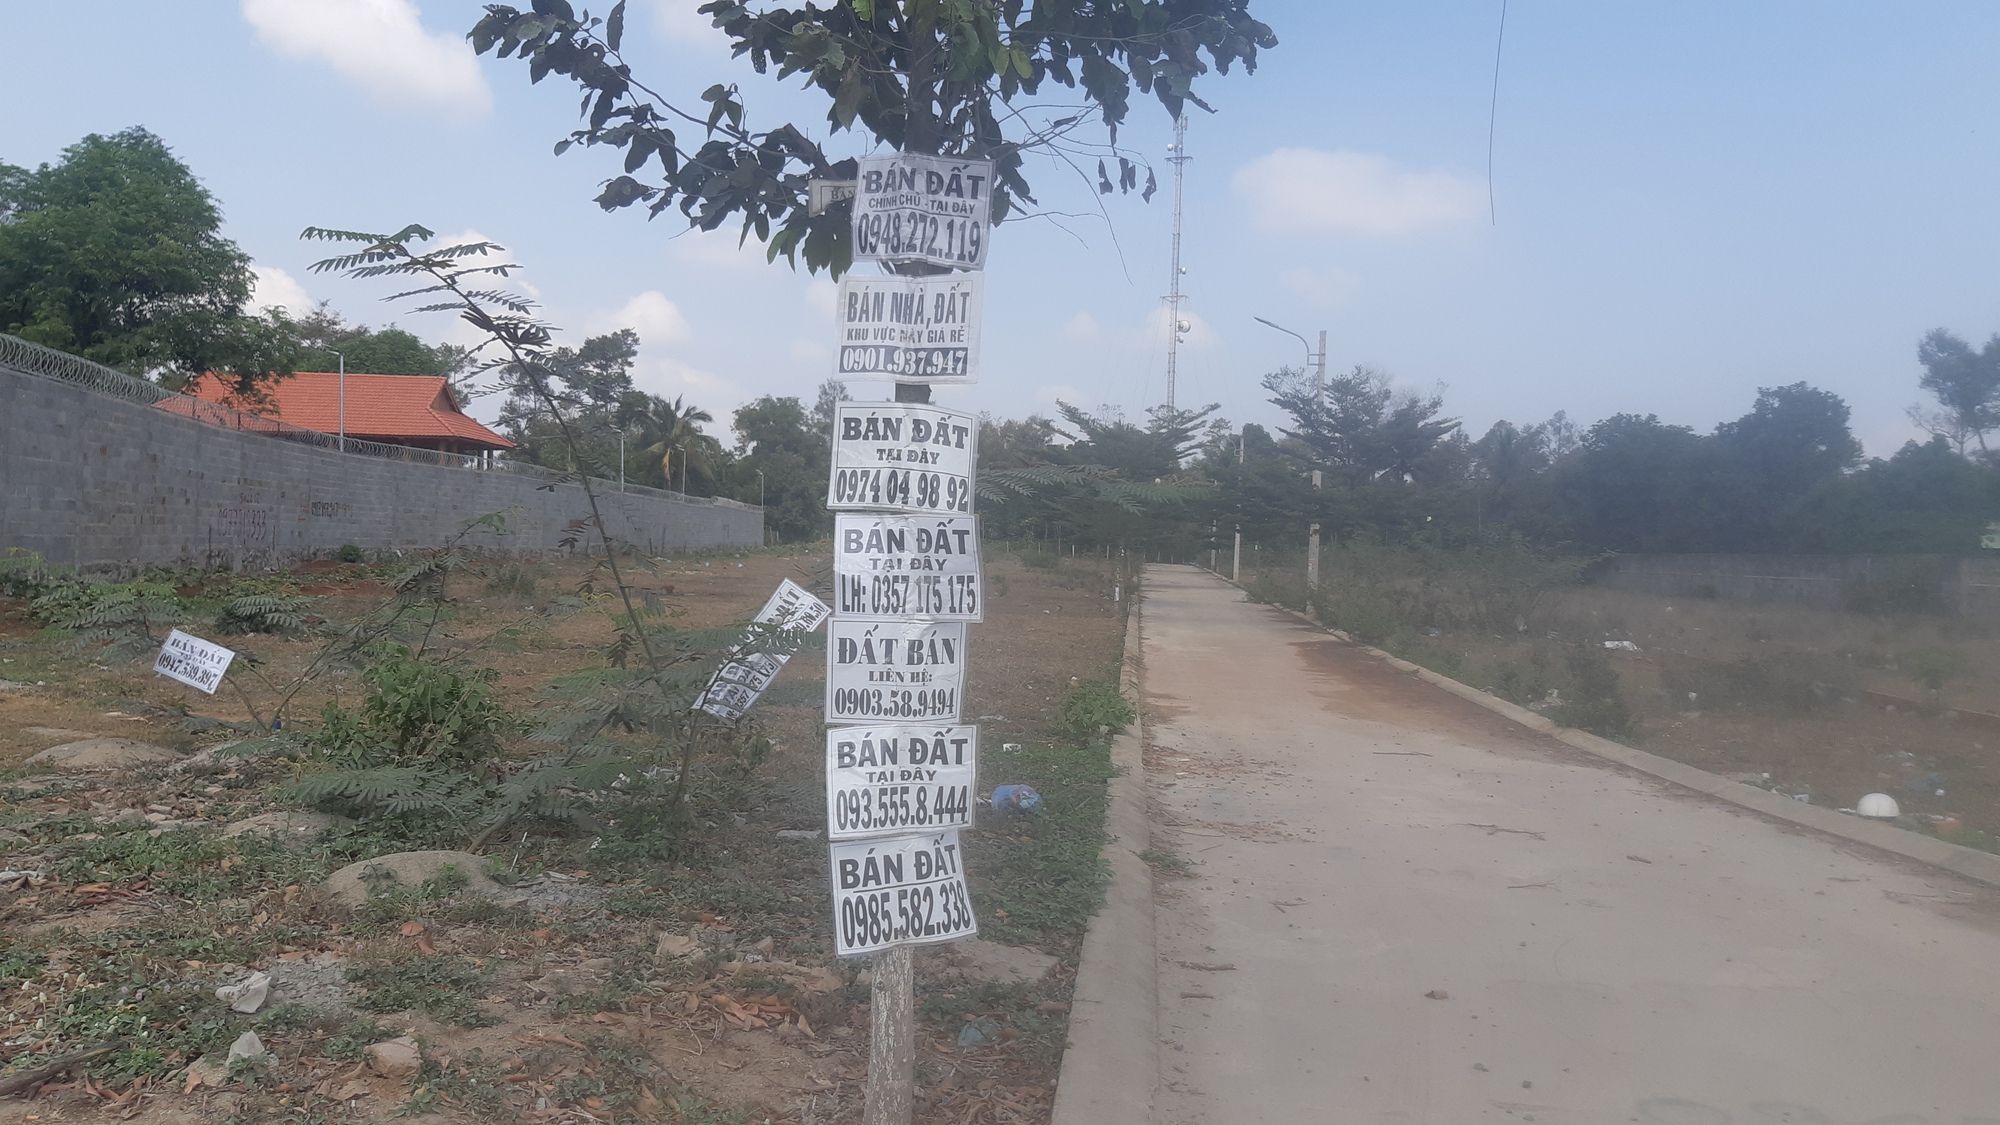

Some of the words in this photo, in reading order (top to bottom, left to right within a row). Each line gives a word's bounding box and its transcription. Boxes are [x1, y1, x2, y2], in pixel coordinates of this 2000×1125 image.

[864, 162, 917, 194] BÁN
[925, 165, 985, 200] ĐẤT
[868, 195, 897, 208] CHÍNH
[900, 193, 921, 207] CHỦ
[930, 200, 948, 213] TẠI
[952, 201, 976, 215] ĐÂY
[858, 211, 981, 263] 0948.272.119
[847, 286, 885, 322] BÁN
[847, 328, 869, 341] KHU
[873, 327, 896, 344] VỰC
[927, 327, 945, 343] GIÁ
[950, 326, 965, 343] RẺ
[843, 348, 966, 375] 0901.937.947
[842, 412, 902, 441] BÁN
[911, 416, 968, 450] ĐẤT
[877, 448, 902, 463] TẠI
[906, 448, 940, 465] ĐÂY
[836, 469, 881, 503] 0974
[887, 469, 910, 505] 04
[916, 472, 941, 509] 98
[947, 476, 968, 512] 92
[843, 522, 905, 554] BÁN
[916, 519, 970, 555] ĐẤT
[869, 558, 902, 573] TẠI
[910, 555, 948, 571] ĐÂY
[842, 574, 866, 613] LH:
[871, 575, 910, 614] 0357
[914, 575, 942, 613] 175
[948, 575, 976, 614] 175
[170, 638, 197, 654] BÁN
[836, 624, 899, 665] ĐẤT
[906, 630, 957, 666] BÁN
[158, 653, 219, 688] 0947.539.397
[868, 668, 905, 683] LIÊN
[910, 668, 932, 686] HỆ:
[835, 687, 955, 717] 0903.58.9494
[837, 732, 898, 769] BÁN
[908, 728, 968, 765] ĐẤT
[865, 770, 895, 784] TẠI
[900, 767, 937, 782] ĐÂY
[836, 785, 968, 830] 093.555.8.444
[839, 848, 903, 890] BÁN
[914, 834, 957, 881] ĐẤT
[842, 880, 971, 948] 0985.582.338
